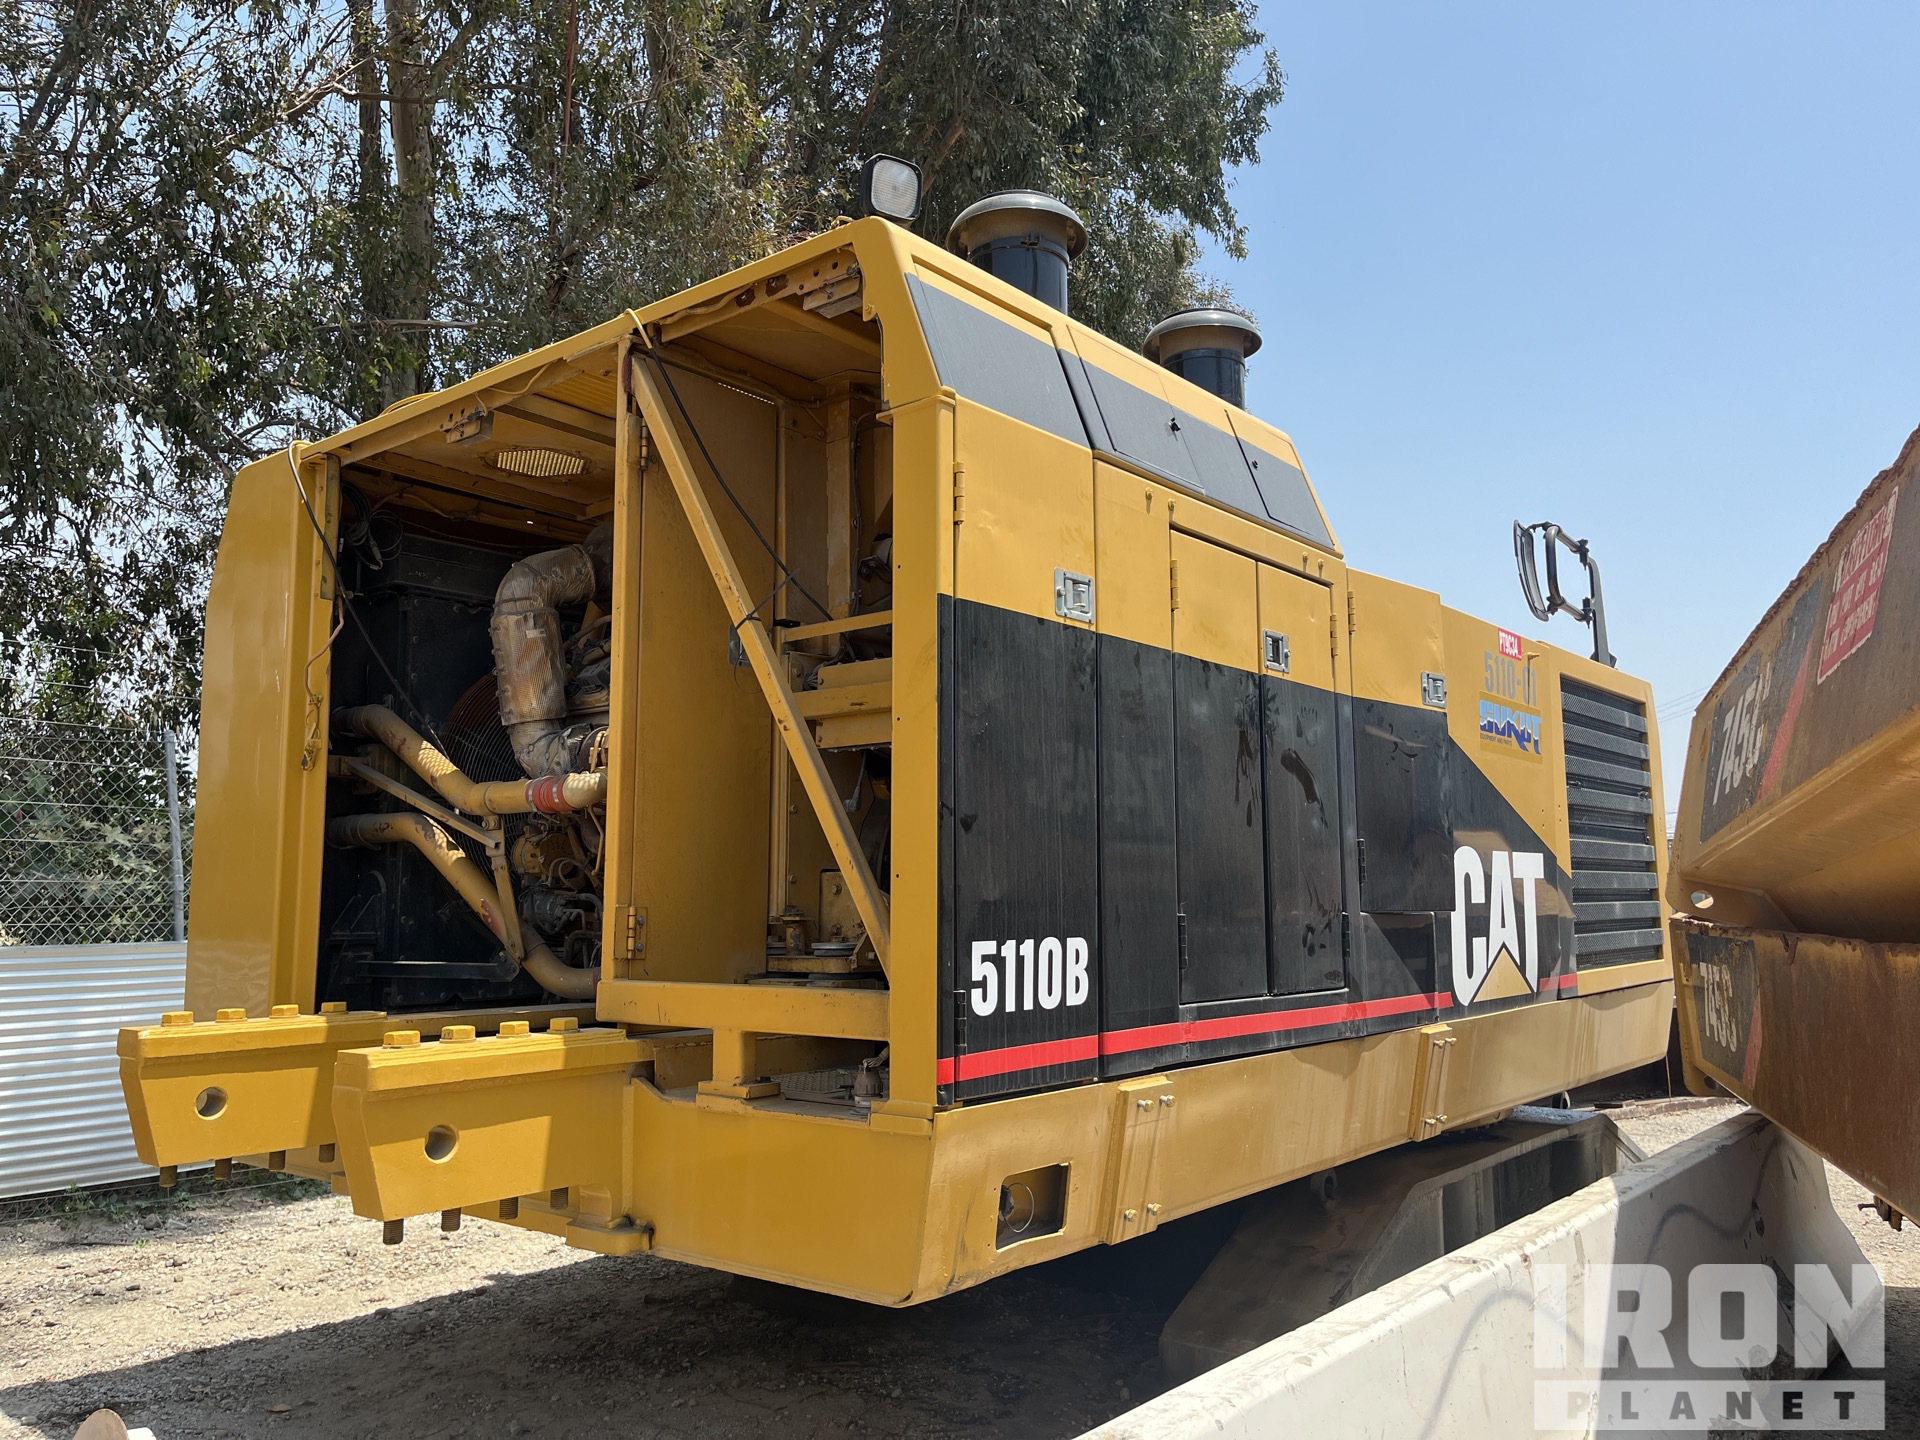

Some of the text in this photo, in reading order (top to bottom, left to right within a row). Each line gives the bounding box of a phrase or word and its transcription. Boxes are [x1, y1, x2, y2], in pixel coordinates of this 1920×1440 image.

[1484, 650, 1537, 707] 5110-01
[1480, 700, 1542, 755] SUKUT
[1451, 845, 1544, 1007] CAT
[971, 936, 1089, 1017] 5110B
